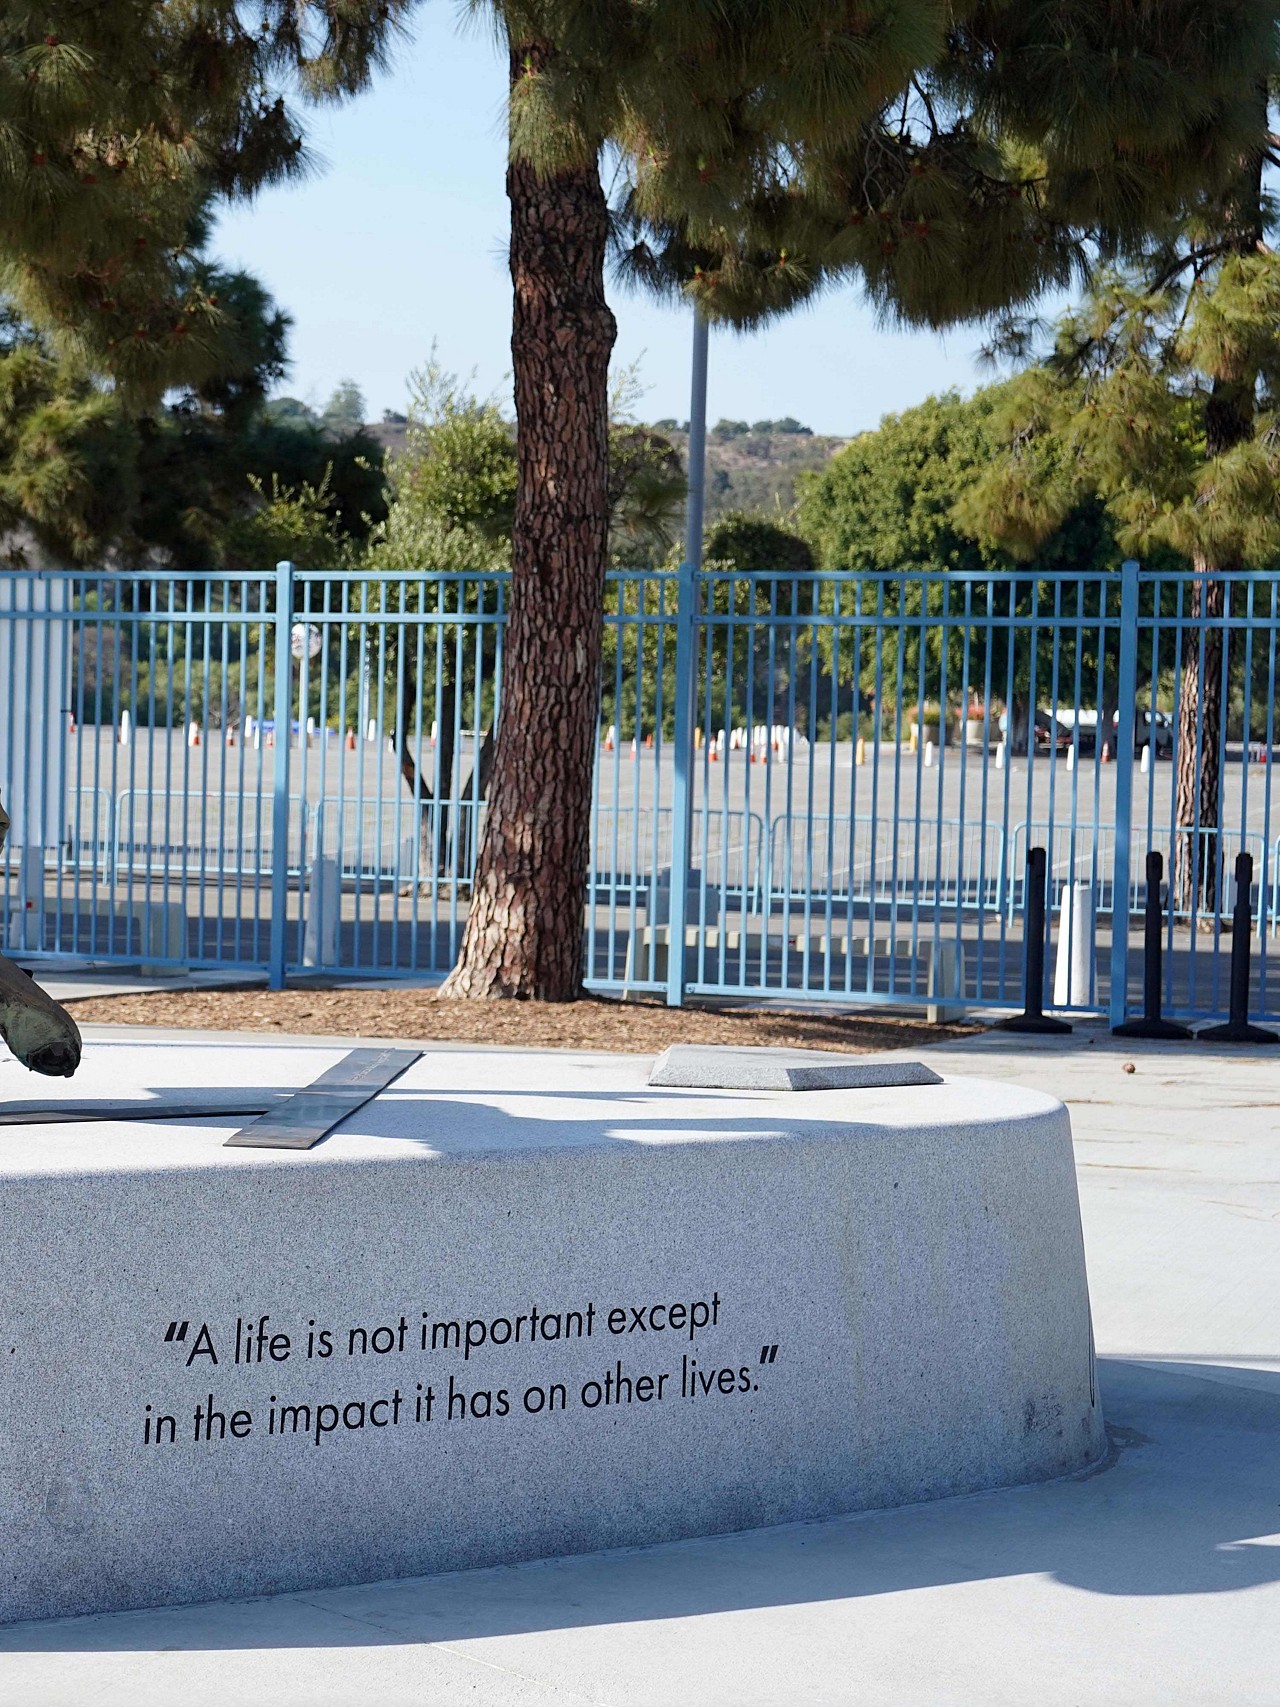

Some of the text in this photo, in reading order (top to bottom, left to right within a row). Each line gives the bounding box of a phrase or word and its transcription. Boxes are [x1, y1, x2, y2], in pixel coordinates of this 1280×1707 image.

[234, 1315, 291, 1365] life
[307, 1319, 334, 1359] is
[348, 1316, 409, 1356] not
[421, 1302, 596, 1361] important
[607, 1291, 721, 1341] except
[143, 1404, 177, 1445] in
[193, 1393, 253, 1442] the
[268, 1389, 403, 1447] impact
[415, 1383, 436, 1423] it
[447, 1375, 510, 1421] has
[523, 1383, 567, 1414] on
[580, 1360, 670, 1409] other
